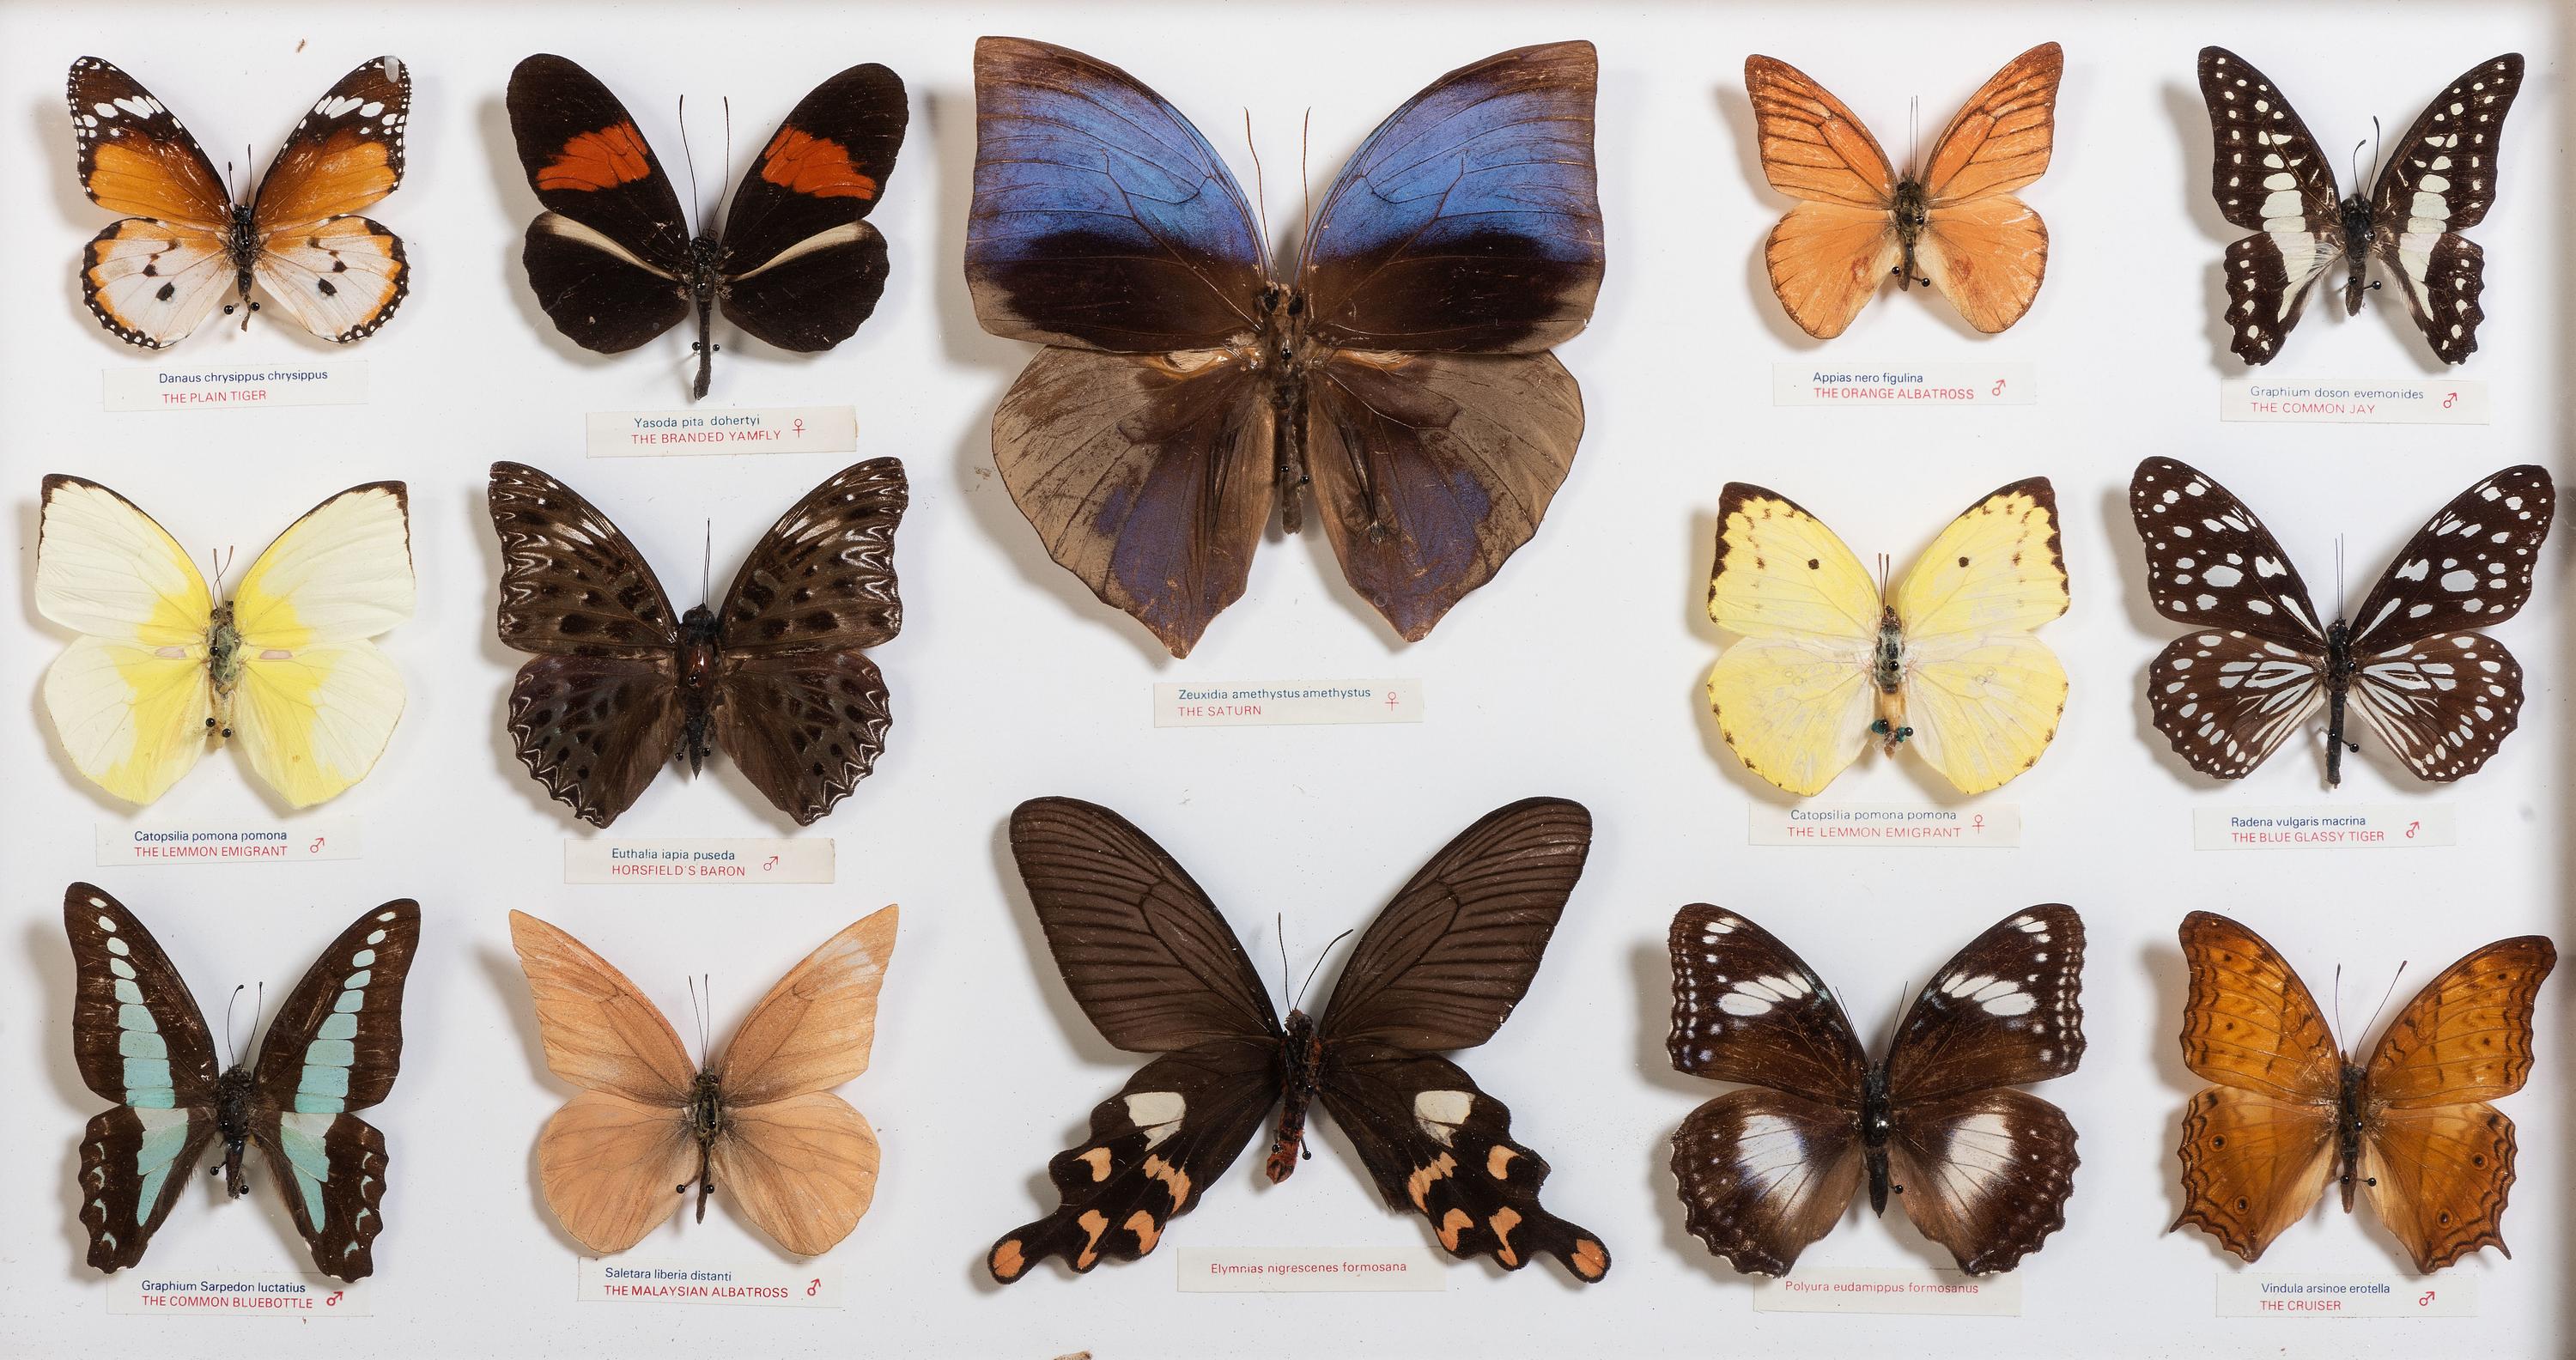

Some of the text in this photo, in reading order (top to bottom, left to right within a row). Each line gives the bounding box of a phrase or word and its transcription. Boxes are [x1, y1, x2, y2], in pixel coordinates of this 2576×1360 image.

[159, 370, 327, 383] Danaus chrysippus chrysippus
[1814, 373, 1923, 385] Appias nero figulina
[162, 391, 266, 404] THE PLAIN TIGER
[1814, 388, 1974, 399] THE ORANGE ALBATROSS
[2251, 386, 2424, 399] Graphium doson evemonides
[2251, 403, 2375, 414] THE COMMON JAY
[635, 416, 760, 428] Yasoda pita dohertyi
[632, 430, 781, 444] THE BRANDED YAMFLY
[1179, 688, 1370, 701] Zeuxidia amethystus amethystus
[1178, 706, 1261, 716] THE SATURN
[1790, 810, 1956, 822] Catopsilia pomona pomona
[2232, 816, 2366, 829] Radena vulgaris macrina
[135, 831, 287, 842] Catopsilia pomona pomona
[1787, 827, 1962, 838] THE LEMMON EMIGRANT
[2233, 831, 2384, 842] THE BLUE GLASSY TIGER
[134, 846, 288, 857] THE LEMMON EMIGRANT
[612, 848, 735, 861] Euthalia iapia puseda
[701, 866, 744, 876] BARON
[605, 1267, 732, 1281] Saletara liberia distanti
[1211, 1262, 1406, 1275] Elymnias nigrescenes formosana
[142, 1280, 306, 1293] Graphium Sarpedon luctatius
[605, 1285, 788, 1298] THE MALAYSIAN ALBATROSS
[1785, 1281, 1978, 1294] Polyura eudamippus formosanus
[2262, 1284, 2390, 1294] Vindula arsinoe erotella
[142, 1296, 313, 1308] THE COMMON BLUEBOTTLE
[2260, 1301, 2341, 1311] THE CRUISER
